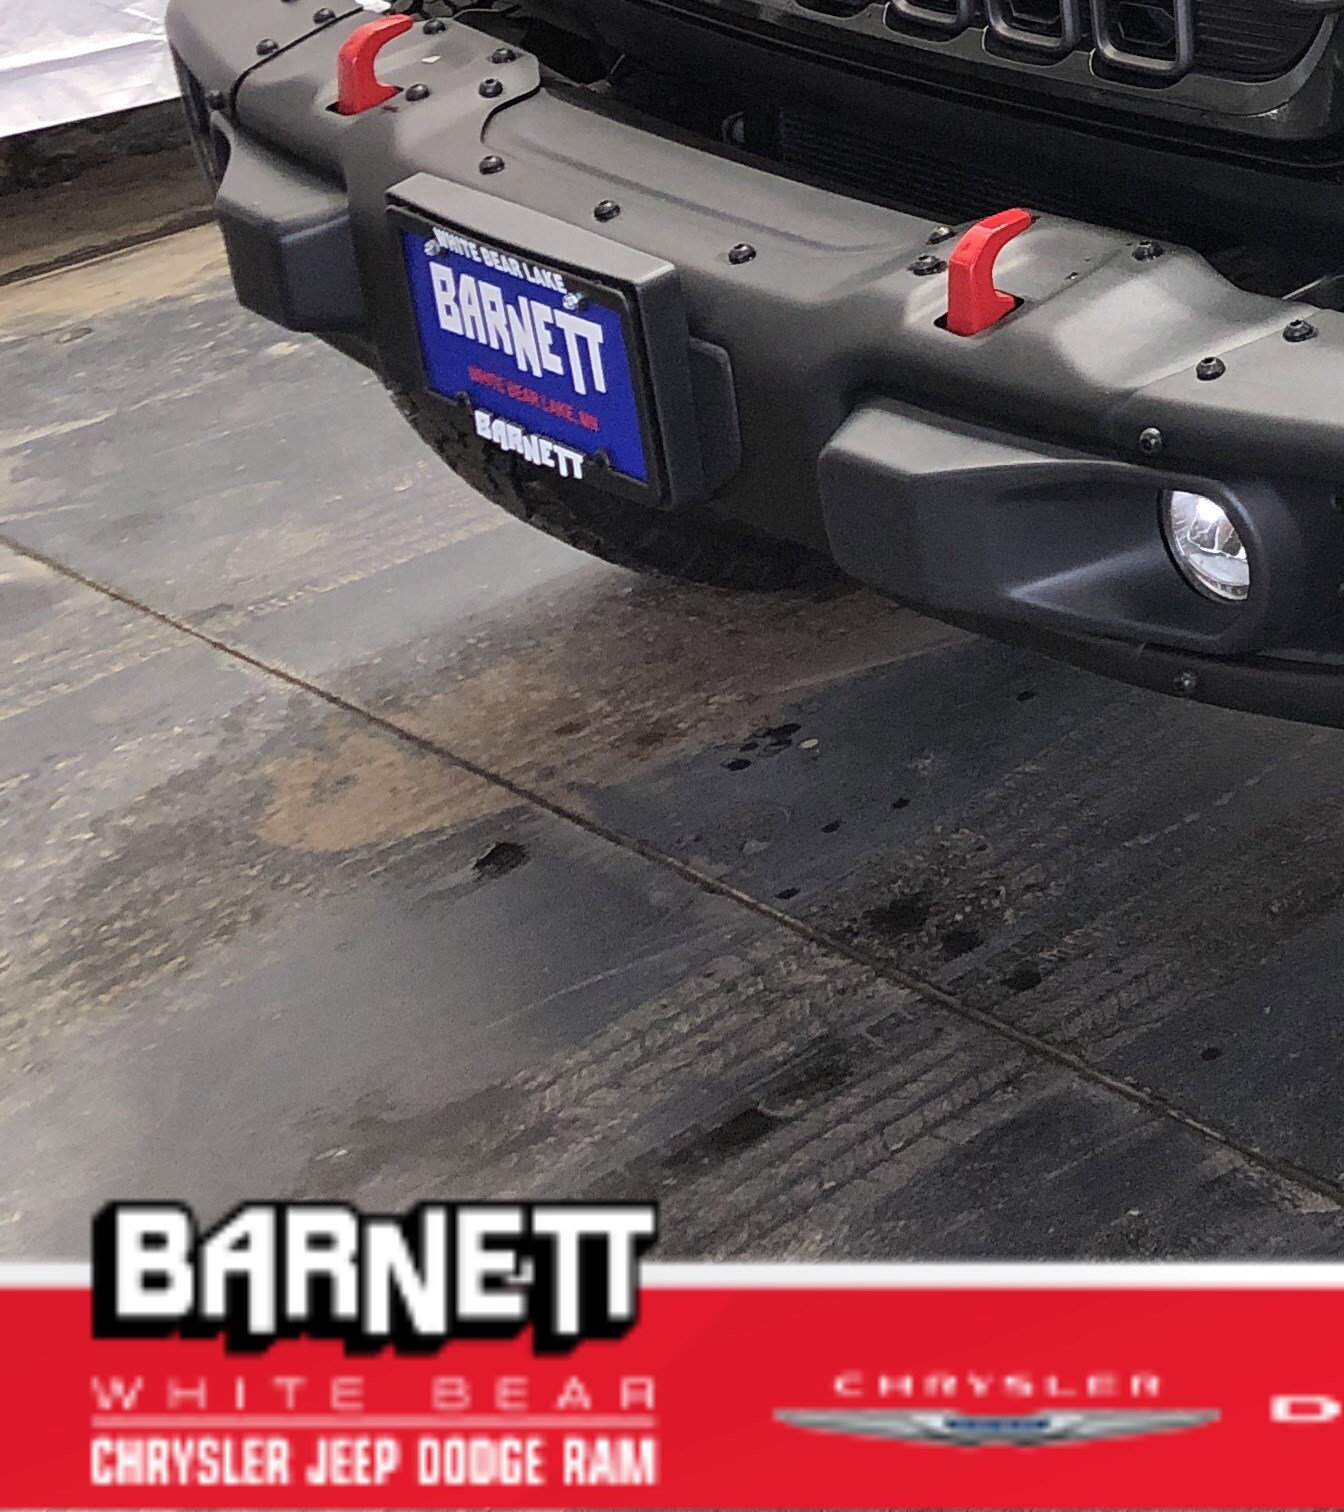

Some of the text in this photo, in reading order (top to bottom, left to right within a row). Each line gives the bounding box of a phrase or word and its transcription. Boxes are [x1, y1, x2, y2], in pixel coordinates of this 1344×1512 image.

[432, 227, 567, 294] WHITE BEAR LAKE
[429, 260, 606, 396] BARNETT
[474, 409, 585, 480] BARNETT
